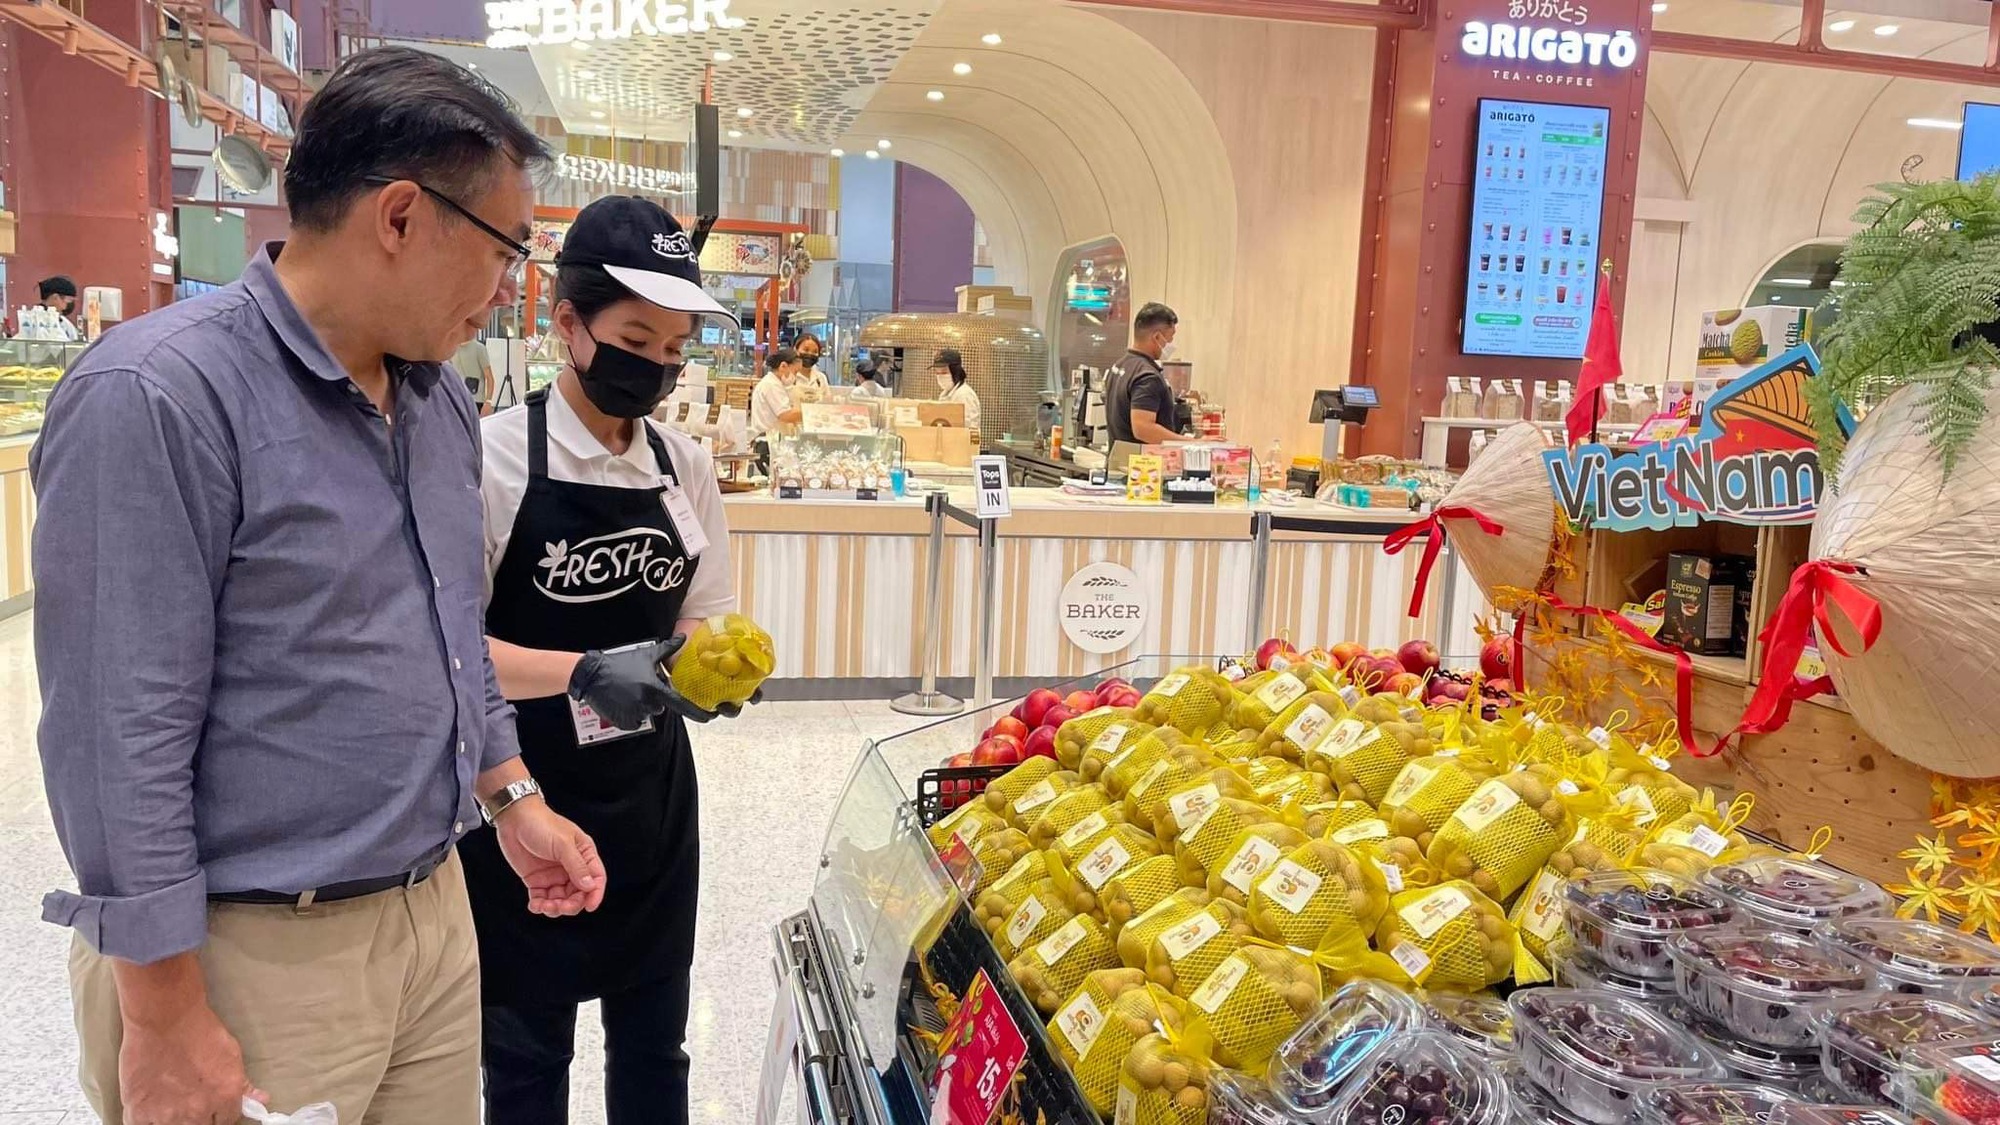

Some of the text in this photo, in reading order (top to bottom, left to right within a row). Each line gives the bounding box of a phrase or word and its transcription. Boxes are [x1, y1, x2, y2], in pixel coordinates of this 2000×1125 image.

[1508, 0, 1588, 26] ありがとう
[1492, 69, 1594, 87] TEA COFFEE
[1702, 331, 1730, 349] Matcha
[981, 469, 1001, 480] Tops
[986, 491, 1001, 507] IN
[544, 537, 654, 590] FRESH
[1671, 578, 1702, 595] Espresso
[1094, 593, 1115, 602] THE
[1647, 598, 1666, 611] Sal
[1066, 603, 1141, 619] BAKER
